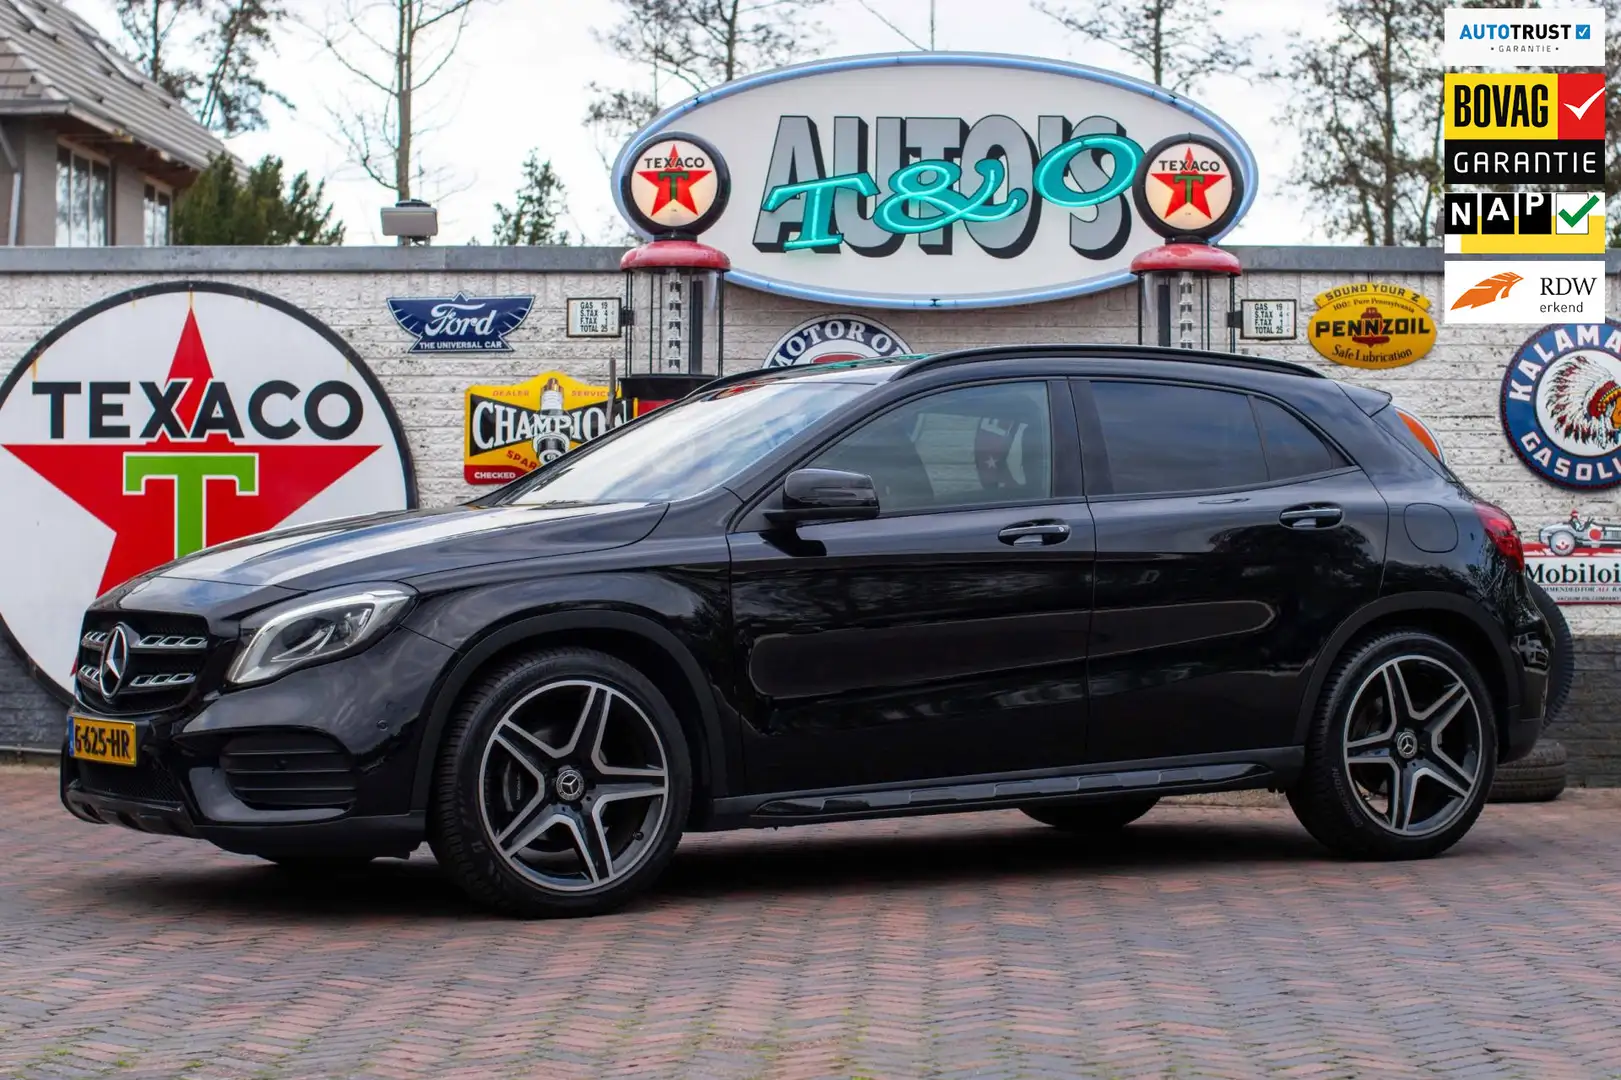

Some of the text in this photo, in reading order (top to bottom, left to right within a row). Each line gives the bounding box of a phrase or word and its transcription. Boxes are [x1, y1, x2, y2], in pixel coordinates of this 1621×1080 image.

[644, 157, 705, 169] TEXACO
[1159, 160, 1220, 172] TEXACO
[1325, 284, 1368, 301] SOUND
[1371, 284, 1406, 297] YOUR
[580, 301, 593, 310] GAS
[1254, 303, 1268, 311] GAS
[425, 303, 497, 337] Ford
[580, 325, 598, 333] TOTAL
[1255, 326, 1274, 334] TOTAL
[1315, 317, 1430, 338] PENNZOIL
[419, 340, 502, 350] THE UNIVERSAL CAR
[1332, 344, 1413, 363] Safe Lubrication
[492, 389, 530, 397] DEALER
[32, 379, 363, 440] TEXACO
[474, 471, 516, 480] CHECKED
